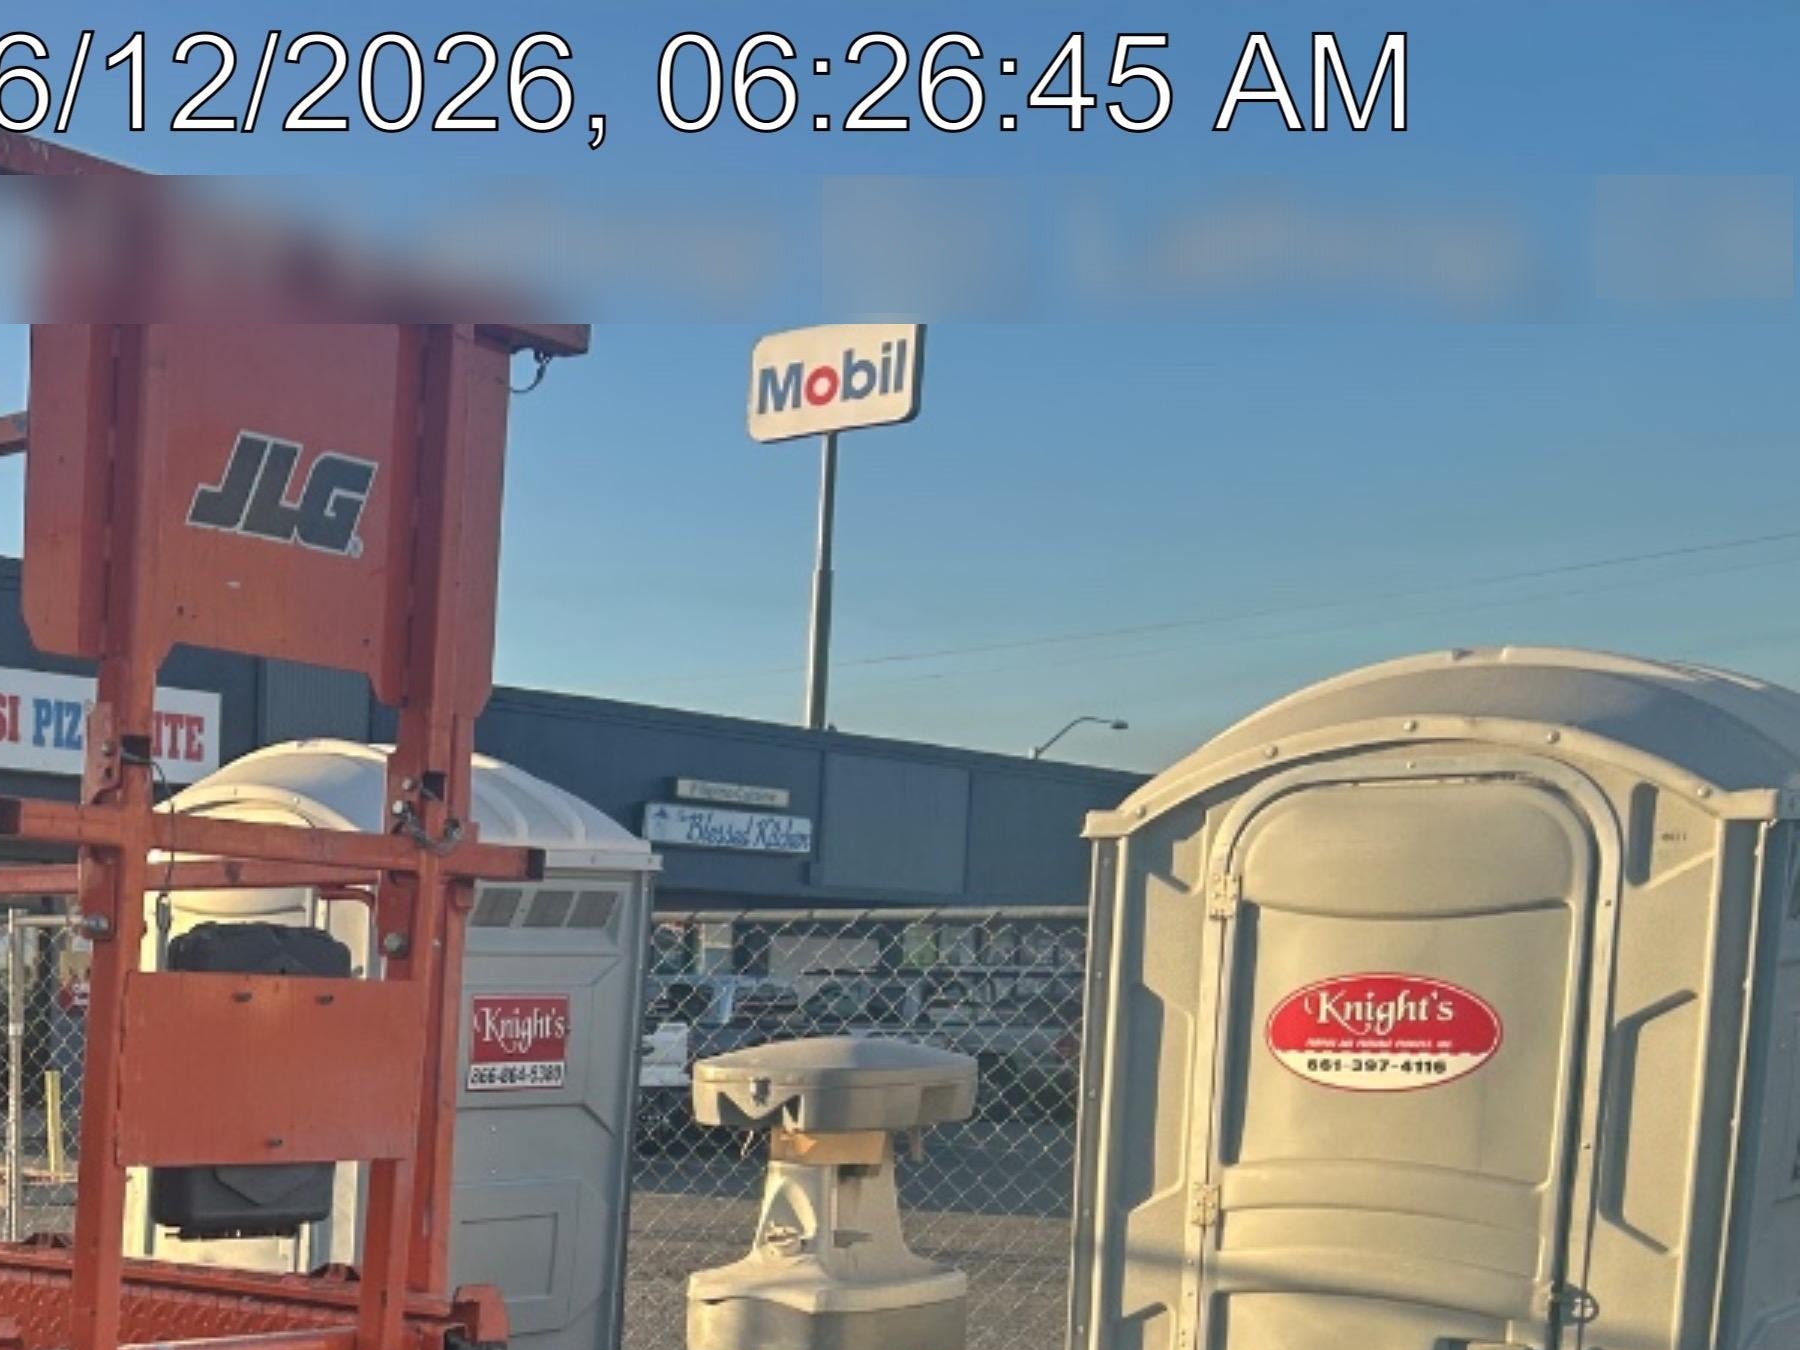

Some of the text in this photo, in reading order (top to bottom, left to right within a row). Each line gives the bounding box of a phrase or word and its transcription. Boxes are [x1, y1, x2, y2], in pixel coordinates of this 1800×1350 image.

[757, 339, 907, 415] Mobil
[185, 430, 379, 557] JLG
[32, 698, 84, 751] PIZ
[152, 710, 205, 762] ITE
[685, 815, 753, 846] Blessed
[751, 818, 811, 849] Kitchen
[473, 1007, 565, 1054] Knight's
[1304, 990, 1454, 1036] Knight's
[1307, 1058, 1448, 1075] 661-397-4116
